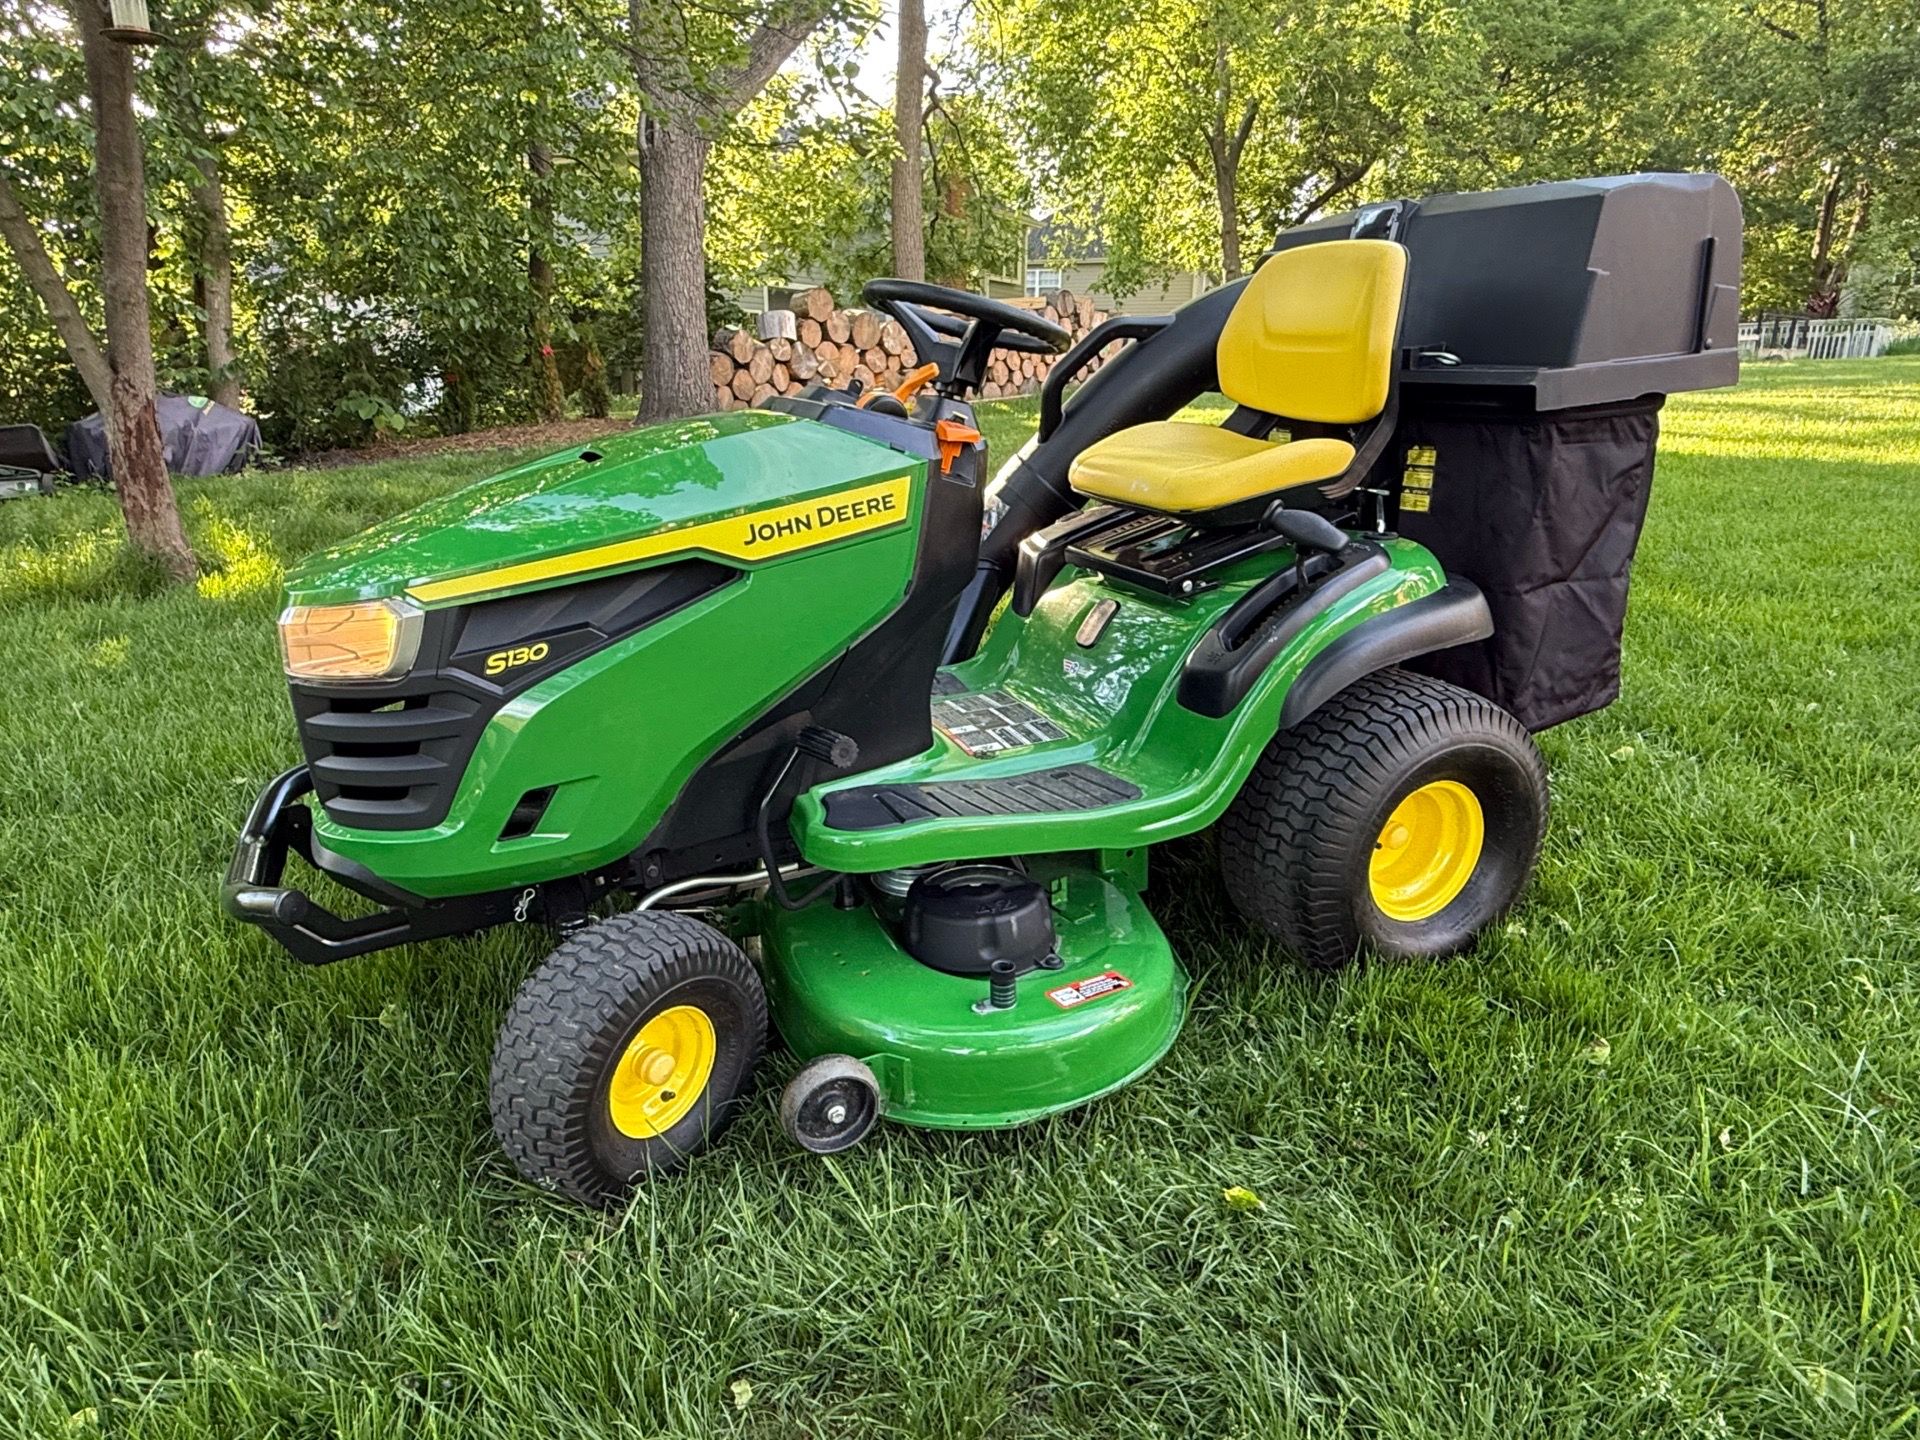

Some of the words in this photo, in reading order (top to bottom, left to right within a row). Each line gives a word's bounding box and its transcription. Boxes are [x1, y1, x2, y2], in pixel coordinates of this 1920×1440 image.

[743, 513, 812, 546] JOHN
[816, 493, 896, 528] DEERE
[485, 642, 549, 675] S130
